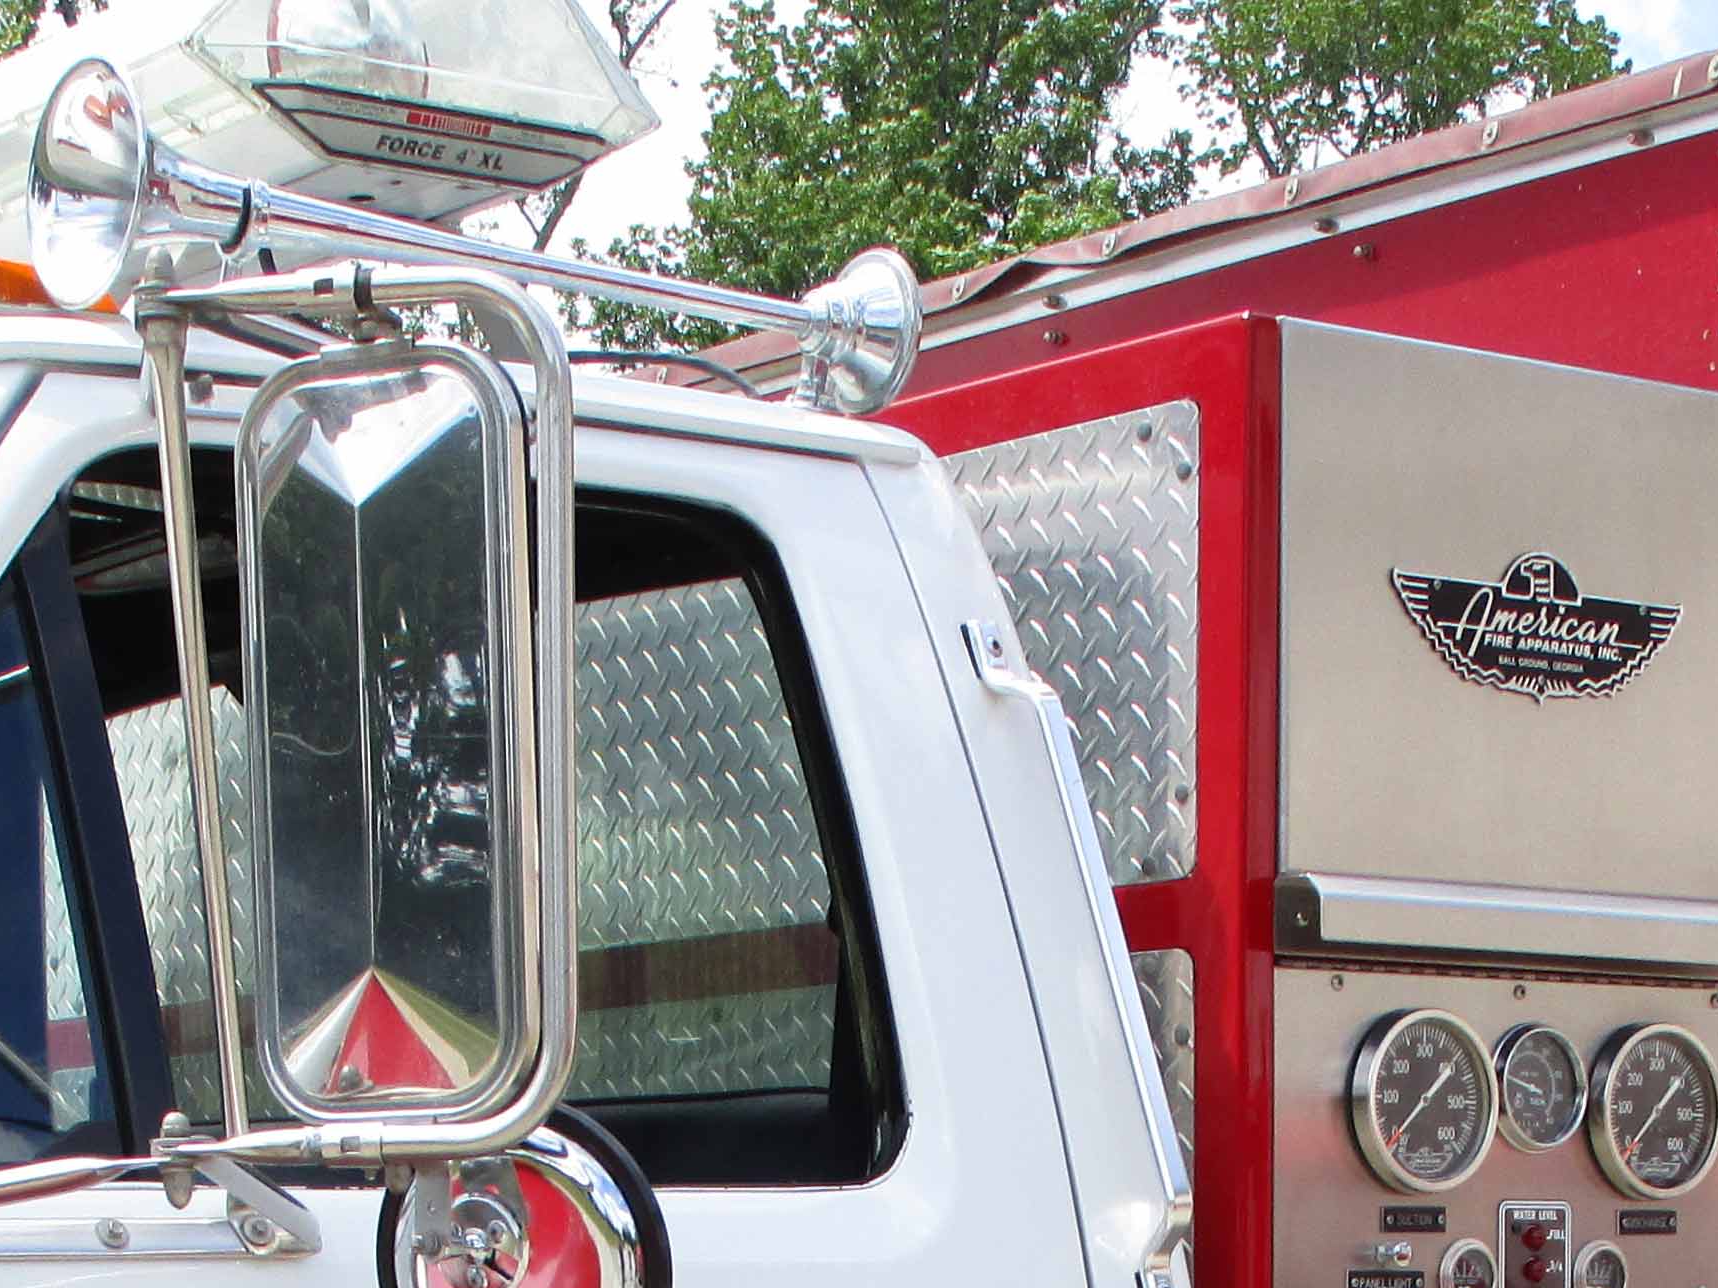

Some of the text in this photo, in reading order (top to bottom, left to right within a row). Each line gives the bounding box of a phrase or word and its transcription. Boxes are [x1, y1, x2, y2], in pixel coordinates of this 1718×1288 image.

[376, 134, 446, 160] FORCE
[1436, 587, 1643, 657] American
[1484, 633, 1623, 662] FIRE APPARATUS, INC.
[1416, 1044, 1434, 1058] 300
[1392, 1059, 1410, 1074] 200
[1649, 1057, 1665, 1072] 300
[1627, 1072, 1644, 1087] 200
[1383, 1090, 1399, 1104] 100
[1447, 1096, 1465, 1109] 500
[1676, 1107, 1693, 1121] 500
[1437, 1126, 1456, 1140] 600
[1667, 1137, 1684, 1151] 600
[1513, 1209, 1558, 1221] WATER LEVEL
[1388, 1277, 1413, 1288] LIGHT
